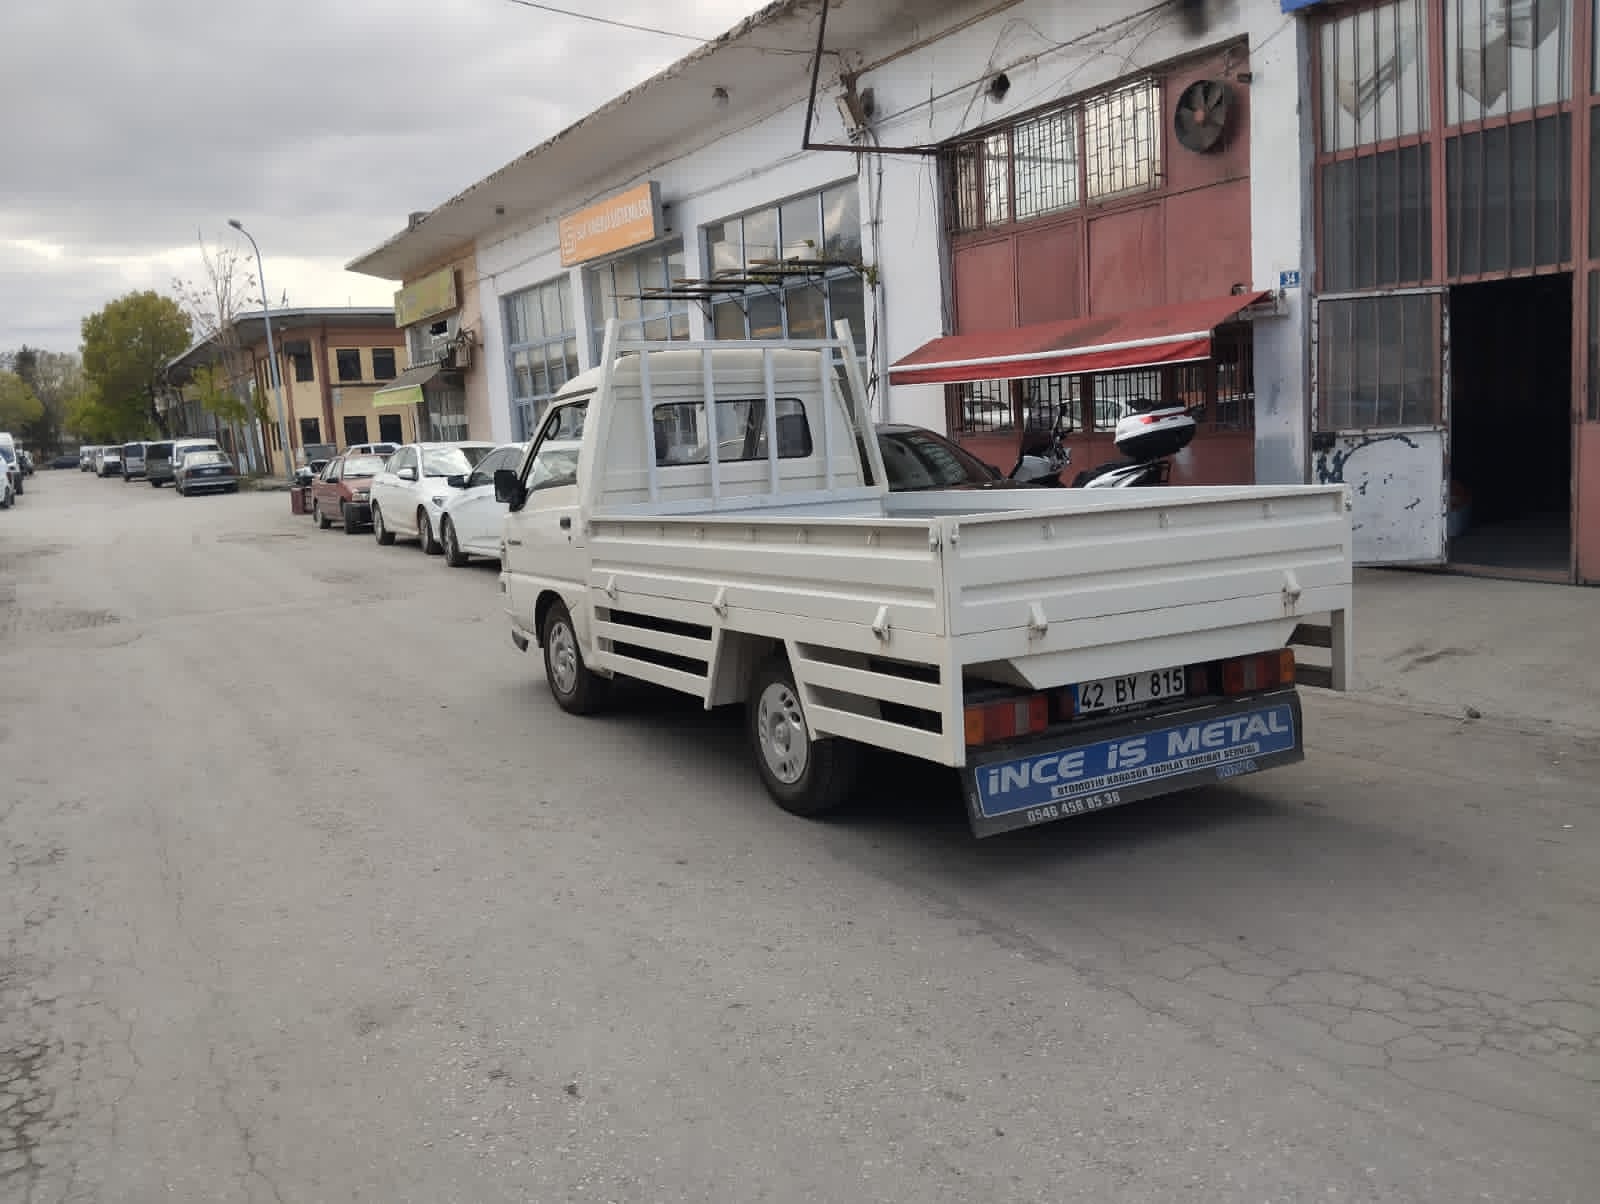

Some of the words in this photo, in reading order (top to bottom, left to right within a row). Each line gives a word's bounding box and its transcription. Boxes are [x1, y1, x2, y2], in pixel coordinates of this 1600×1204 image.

[1082, 682, 1105, 709] 42
[1115, 676, 1137, 703] BY
[1151, 669, 1184, 697] 815
[1167, 712, 1289, 757] METAL
